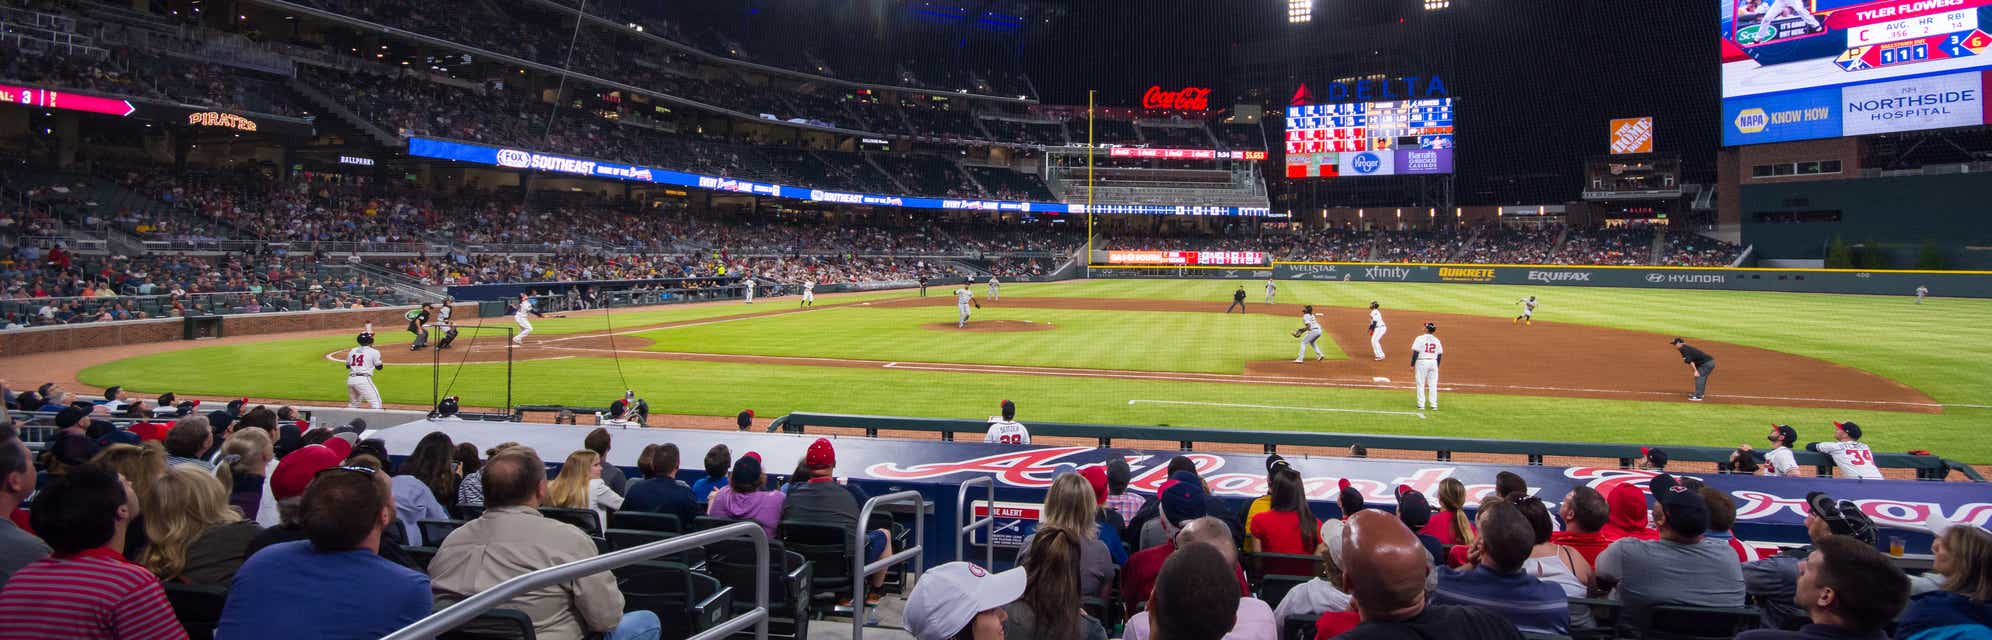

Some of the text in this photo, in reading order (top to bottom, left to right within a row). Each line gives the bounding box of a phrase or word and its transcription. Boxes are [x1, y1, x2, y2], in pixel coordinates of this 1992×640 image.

[1856, 0, 1964, 21] TYLER FLOWERS
[1919, 17, 1934, 26] HR
[1947, 12, 1965, 22] RBI
[1859, 29, 1870, 42] C
[1923, 26, 1929, 34] 2
[1951, 36, 1959, 44] 3
[1971, 36, 1982, 47] 6
[1885, 47, 1924, 62] 1 1 1
[1952, 47, 1960, 56] 1
[1328, 75, 1448, 101] DELTA
[22, 90, 32, 105] 3
[1143, 85, 1211, 110] Coca-Cola
[1849, 89, 1976, 112] NORTHSIDE
[1771, 107, 1829, 124] KNOW HOW
[1871, 106, 1951, 121] HOSPITAL
[189, 111, 257, 131] PIRATES
[1740, 115, 1764, 127] NAPA
[1611, 118, 1652, 153] HOME
[1626, 130, 1652, 152] DEPOT
[505, 151, 524, 162] FOX
[531, 154, 596, 175] SOUTHEAST
[1354, 155, 1379, 172] Kroger
[1289, 265, 1336, 273] WELLSTAR
[1365, 266, 1410, 280] xfinity
[1438, 267, 1496, 277] QUIKRETE
[1528, 270, 1590, 282] EQUIFAX
[1668, 274, 1725, 283] HYUNDAI
[1425, 343, 1436, 353] 12
[351, 354, 364, 366] 14
[1846, 450, 1874, 466] 34
[1002, 509, 1023, 517] ALERT
